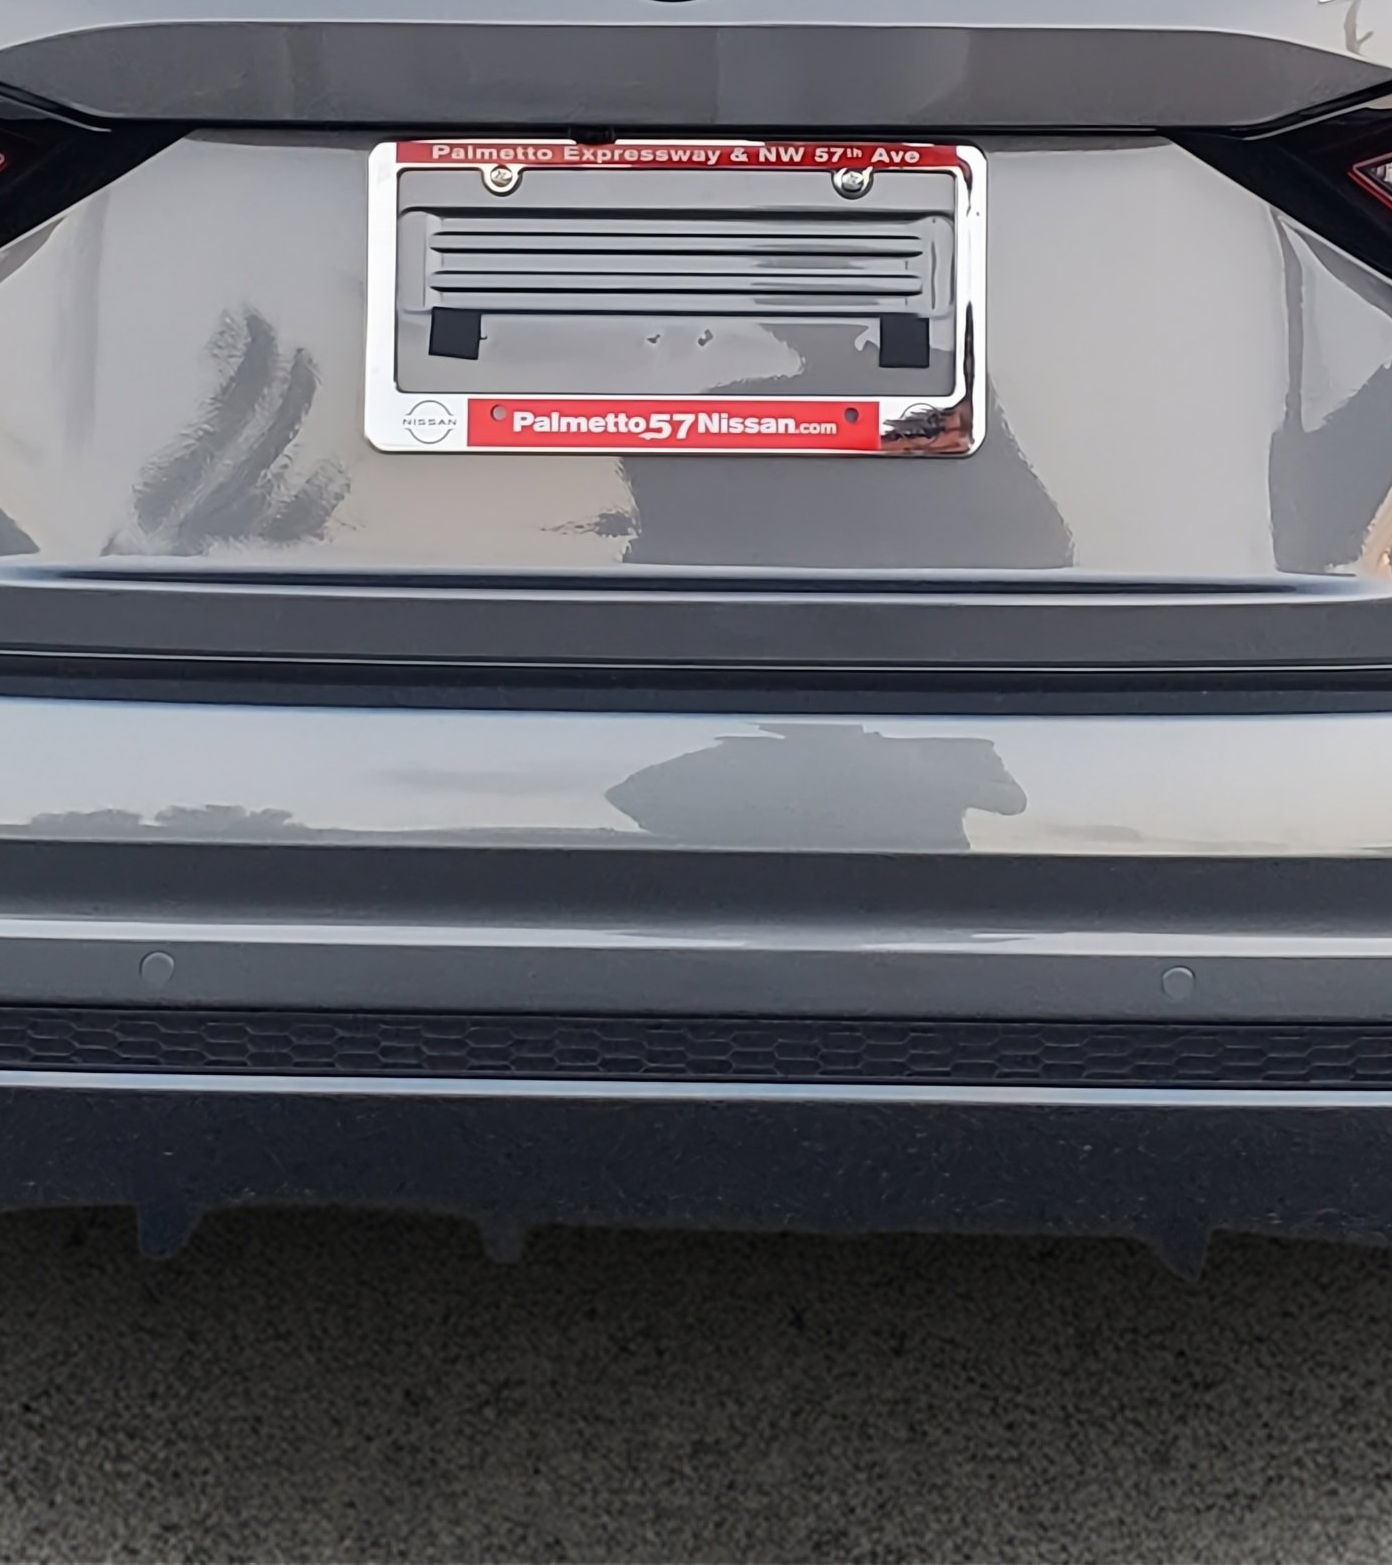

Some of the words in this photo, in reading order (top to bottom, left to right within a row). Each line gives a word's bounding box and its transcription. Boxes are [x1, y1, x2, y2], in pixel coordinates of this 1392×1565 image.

[432, 144, 553, 161] Palmetto
[563, 146, 721, 165] Expressway
[730, 147, 749, 162] &
[759, 146, 805, 163] NW
[871, 147, 920, 164] Ave
[402, 418, 458, 427] NISSAN
[512, 410, 837, 441] Palmetto57Nissan.com
